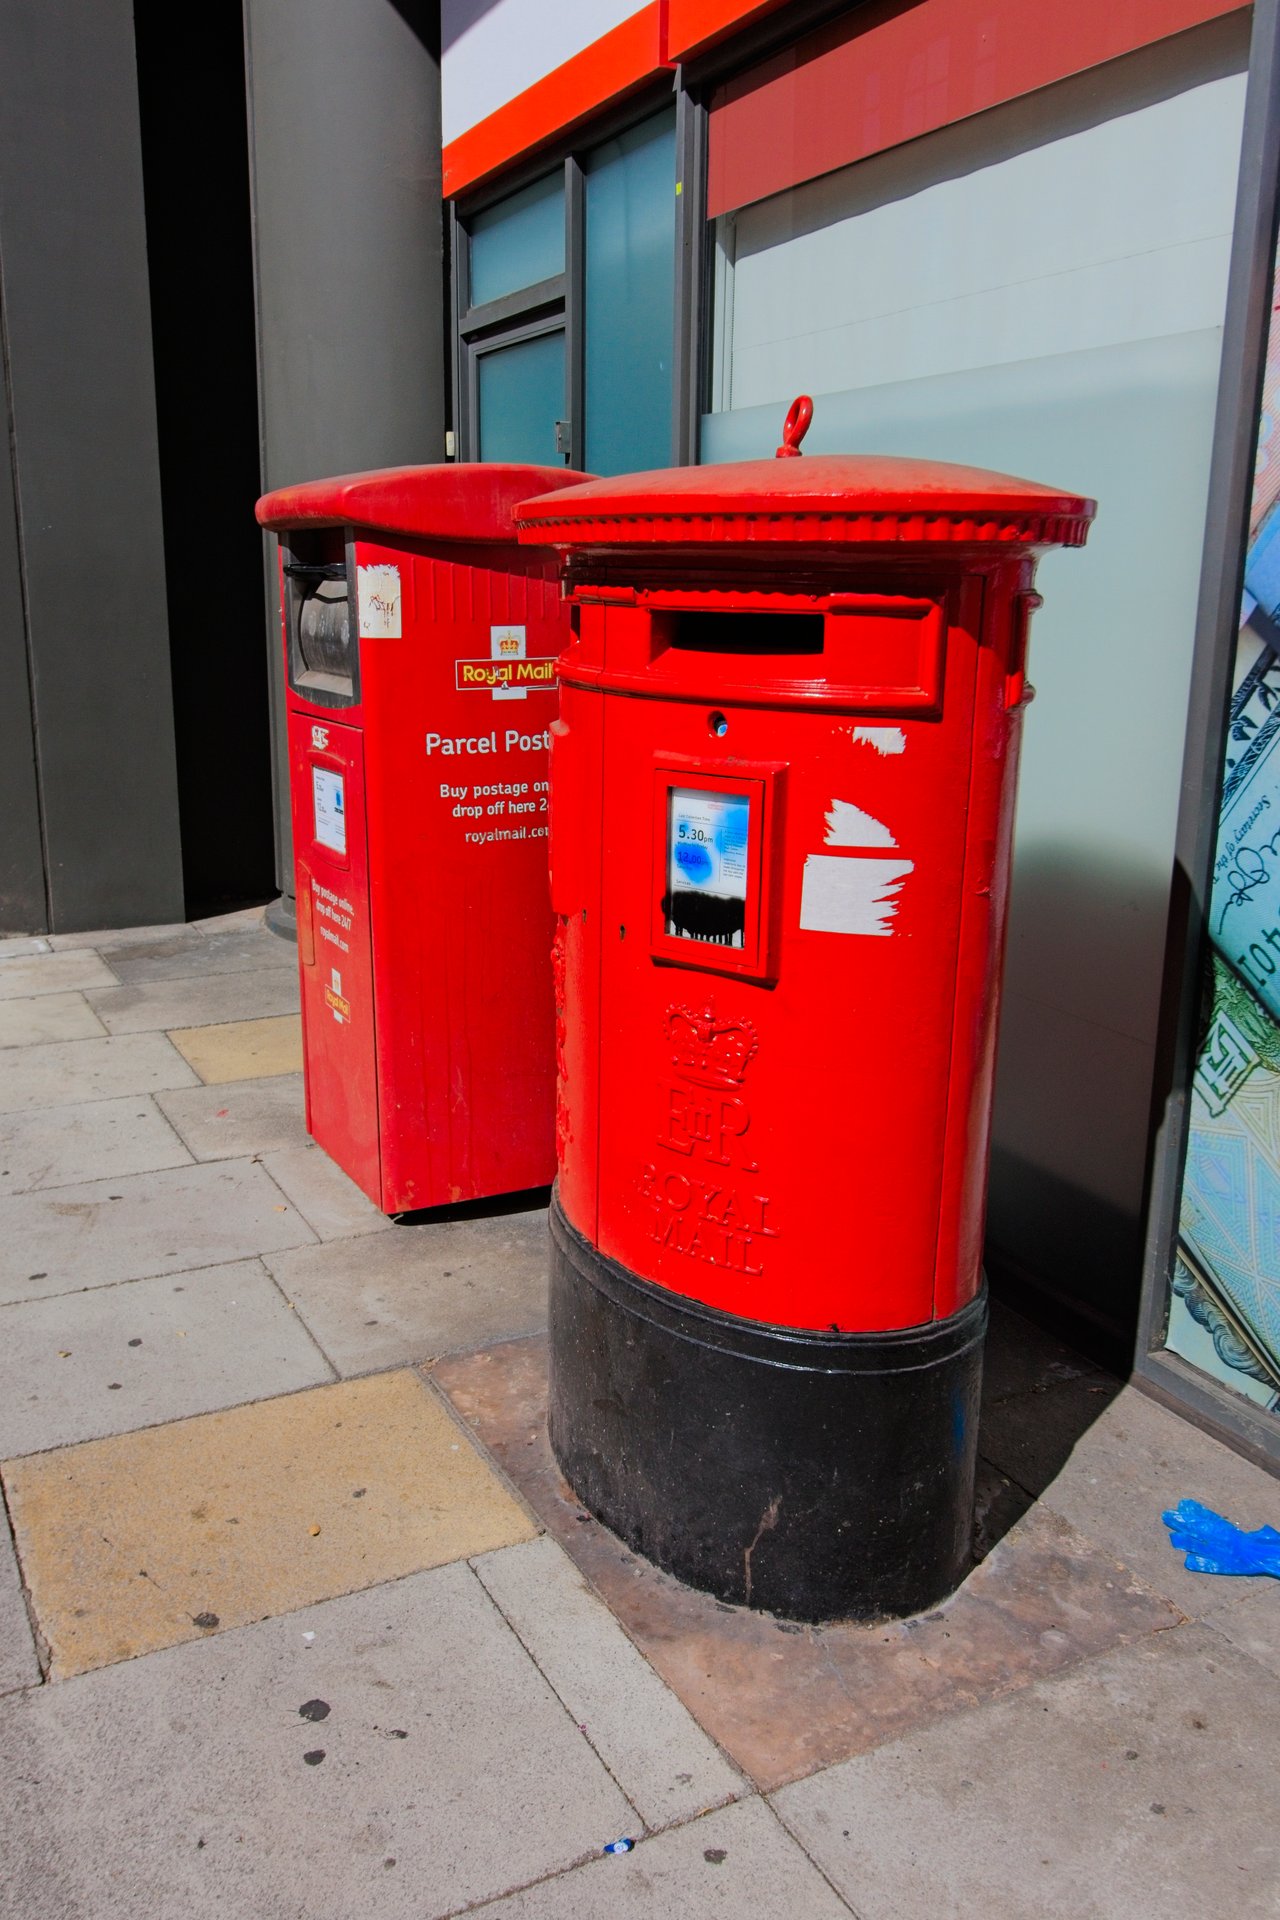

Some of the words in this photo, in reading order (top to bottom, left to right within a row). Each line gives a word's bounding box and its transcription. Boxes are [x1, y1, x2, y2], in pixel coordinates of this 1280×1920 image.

[463, 664, 512, 685] Royal
[516, 662, 553, 680] Mail
[426, 731, 497, 755] Parcel
[505, 729, 550, 752] Post
[440, 783, 468, 799] Buy
[473, 782, 529, 799] postage
[533, 780, 549, 793] on
[452, 803, 483, 819] drop
[487, 801, 505, 816] off
[508, 800, 536, 814] here
[539, 798, 550, 812] 2
[634, 1160, 781, 1239] ROYAL
[646, 1205, 764, 1277] MAIL
